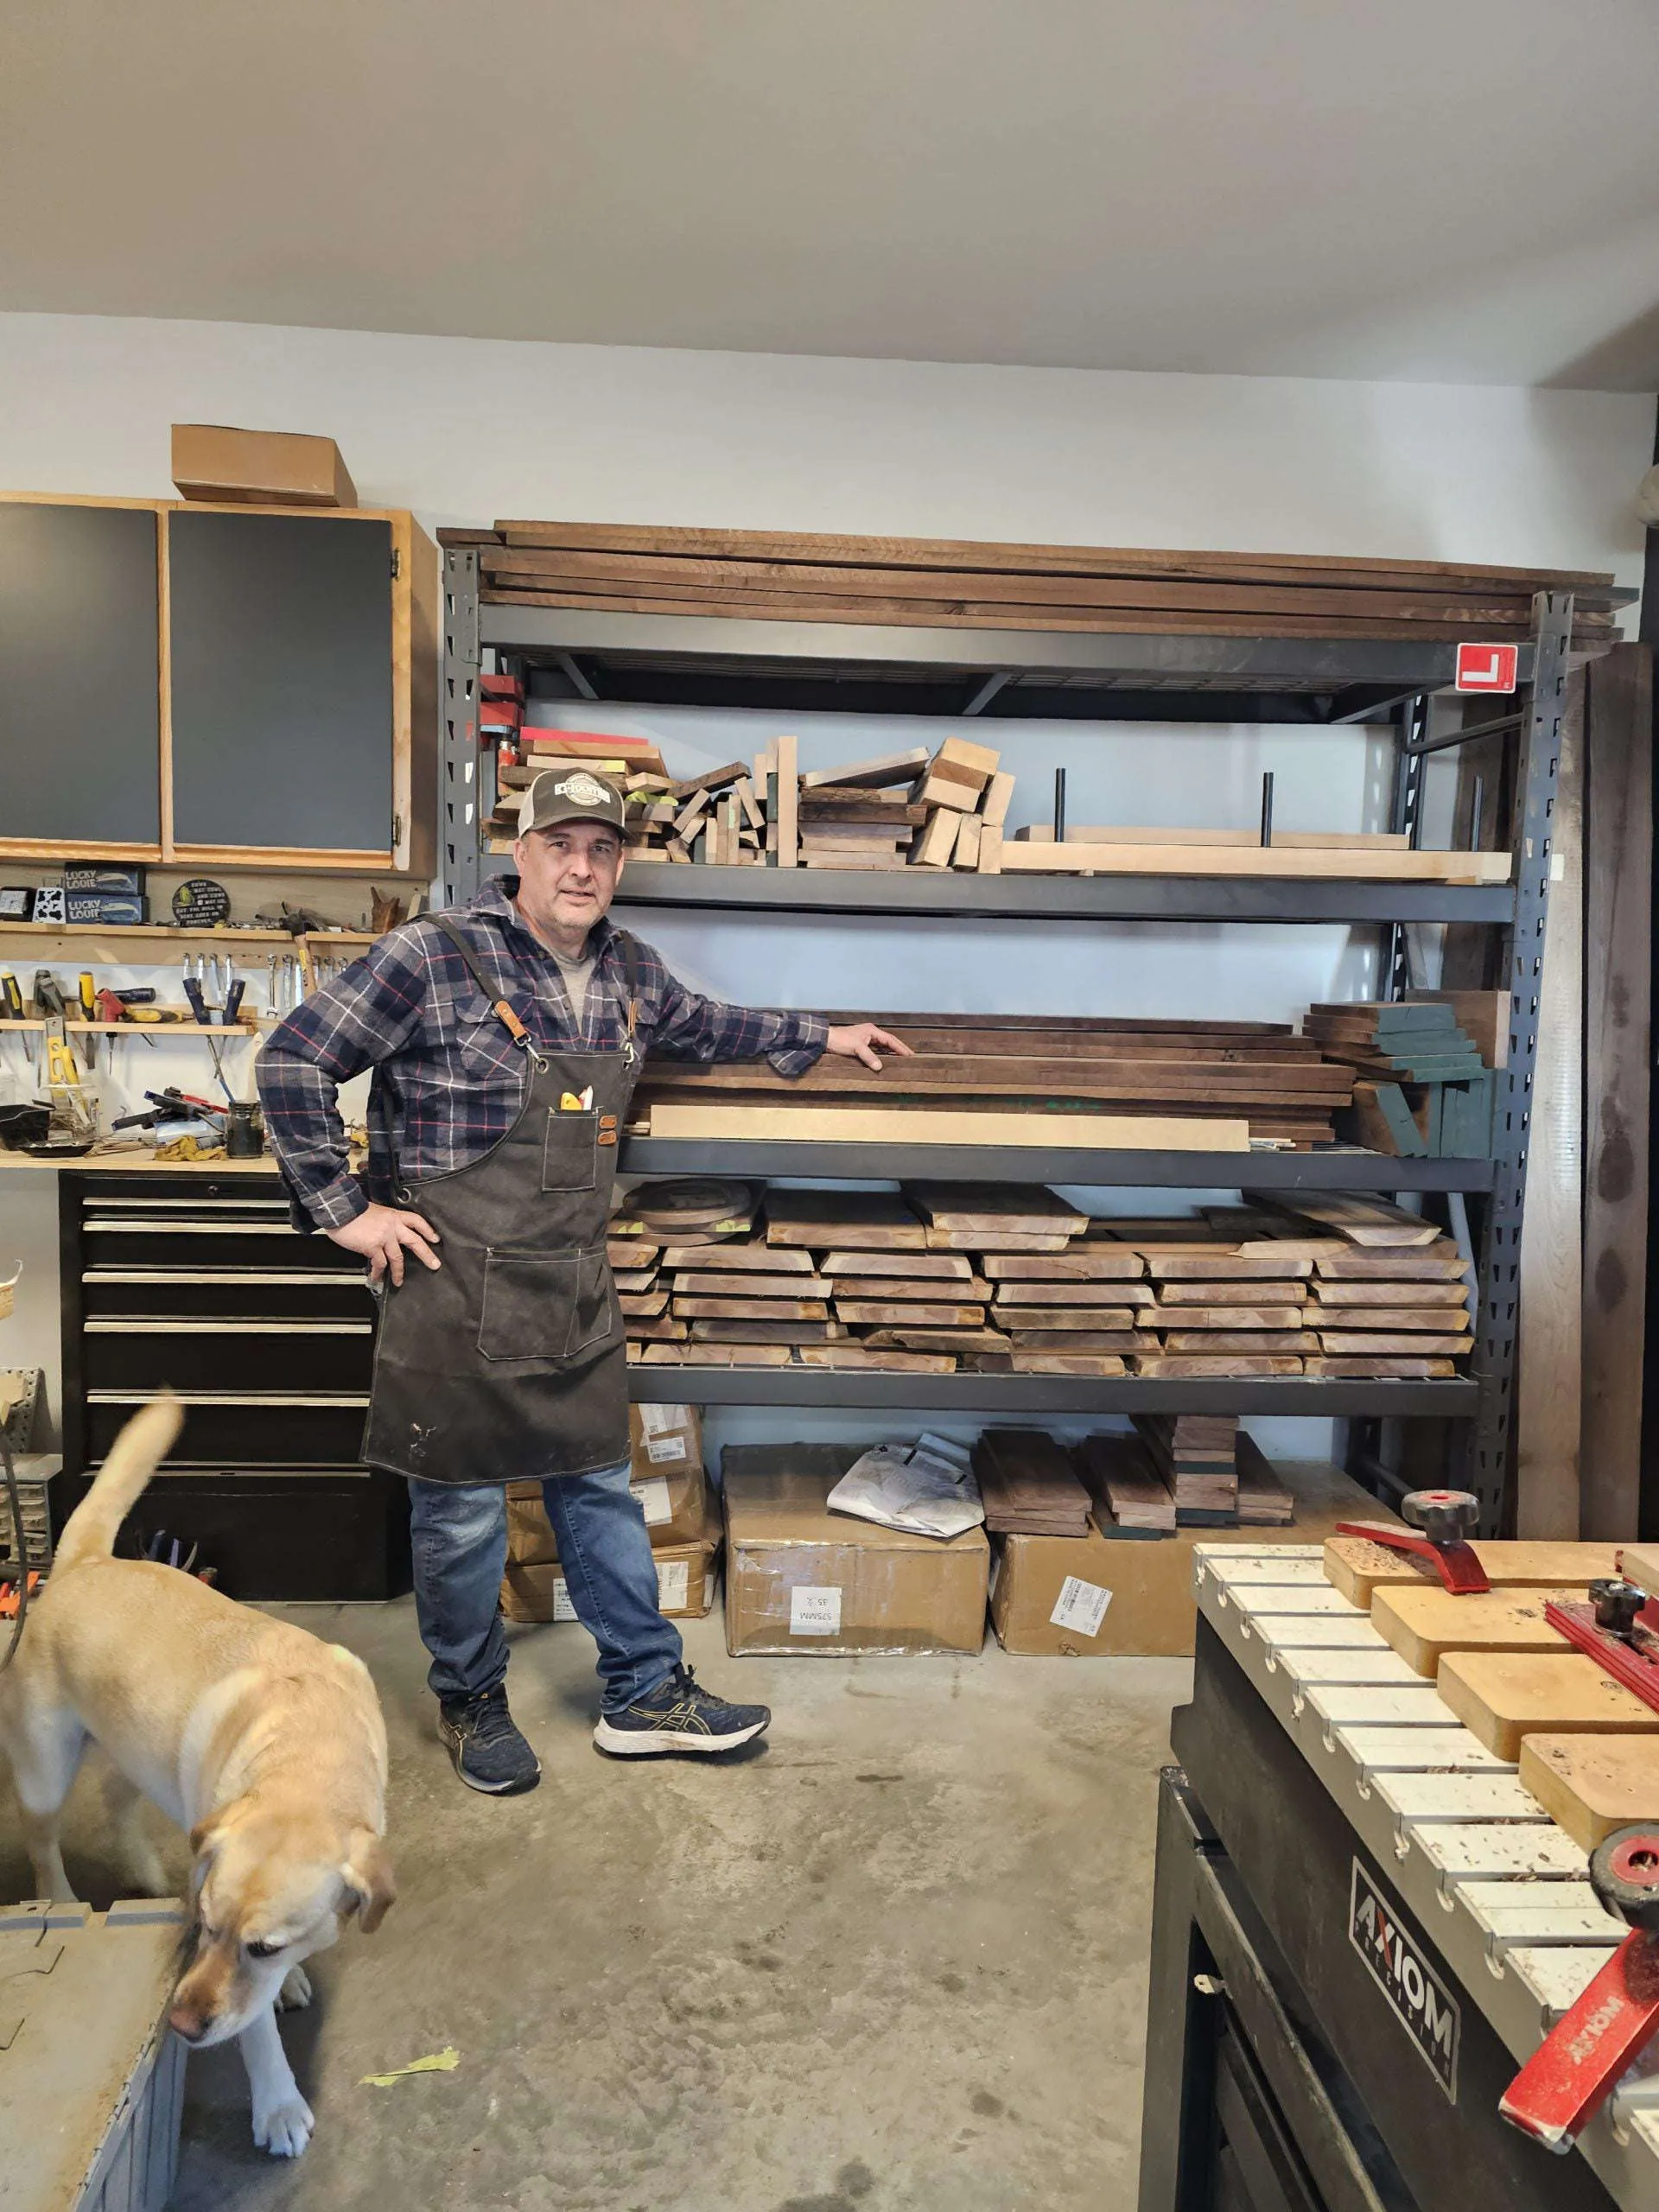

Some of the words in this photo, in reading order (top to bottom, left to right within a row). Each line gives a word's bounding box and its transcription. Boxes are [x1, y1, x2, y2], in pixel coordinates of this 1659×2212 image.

[66, 870, 97, 880] LUCKY
[68, 899, 100, 910] LUCKY
[1357, 1894, 1453, 2059] AXIOM
[1564, 1995, 1624, 2066] AXIOM
